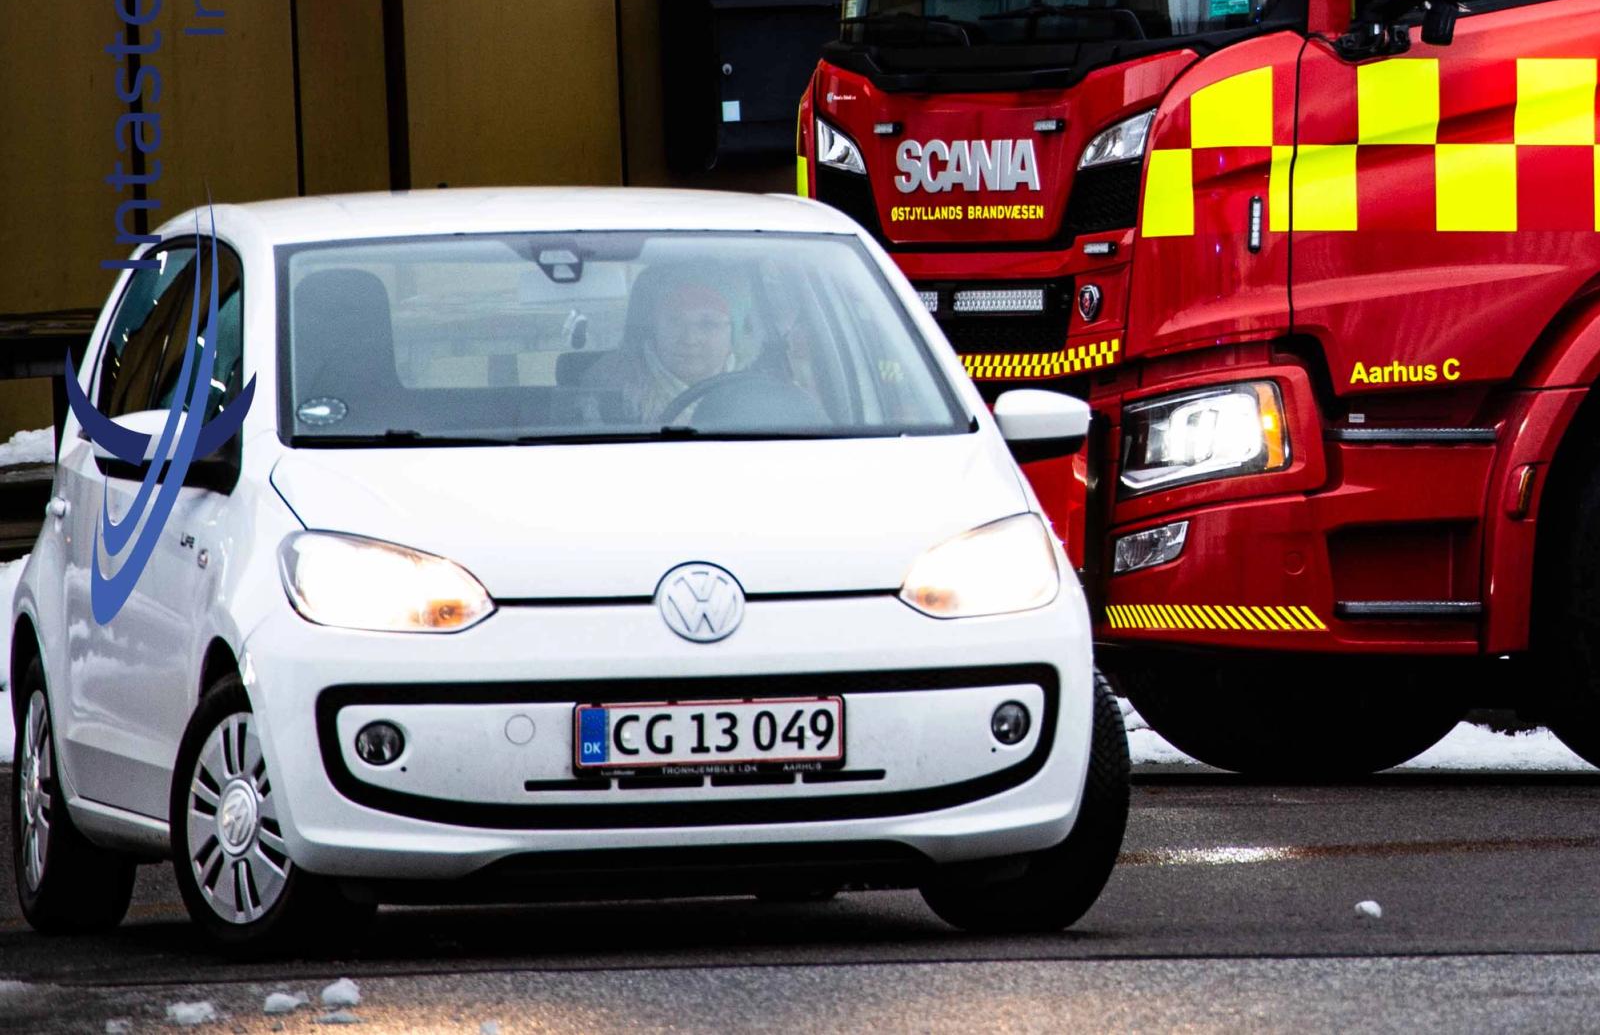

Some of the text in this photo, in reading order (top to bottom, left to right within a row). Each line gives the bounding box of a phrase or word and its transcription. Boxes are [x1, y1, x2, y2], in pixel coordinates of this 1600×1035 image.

[894, 139, 1041, 193] SCANIA
[891, 205, 1044, 221] ØSTJYLLANDS BRANDVÆSEN
[1350, 358, 1460, 384] Aarhus C
[613, 708, 834, 755] CG 13 049
[584, 743, 601, 755] DK
